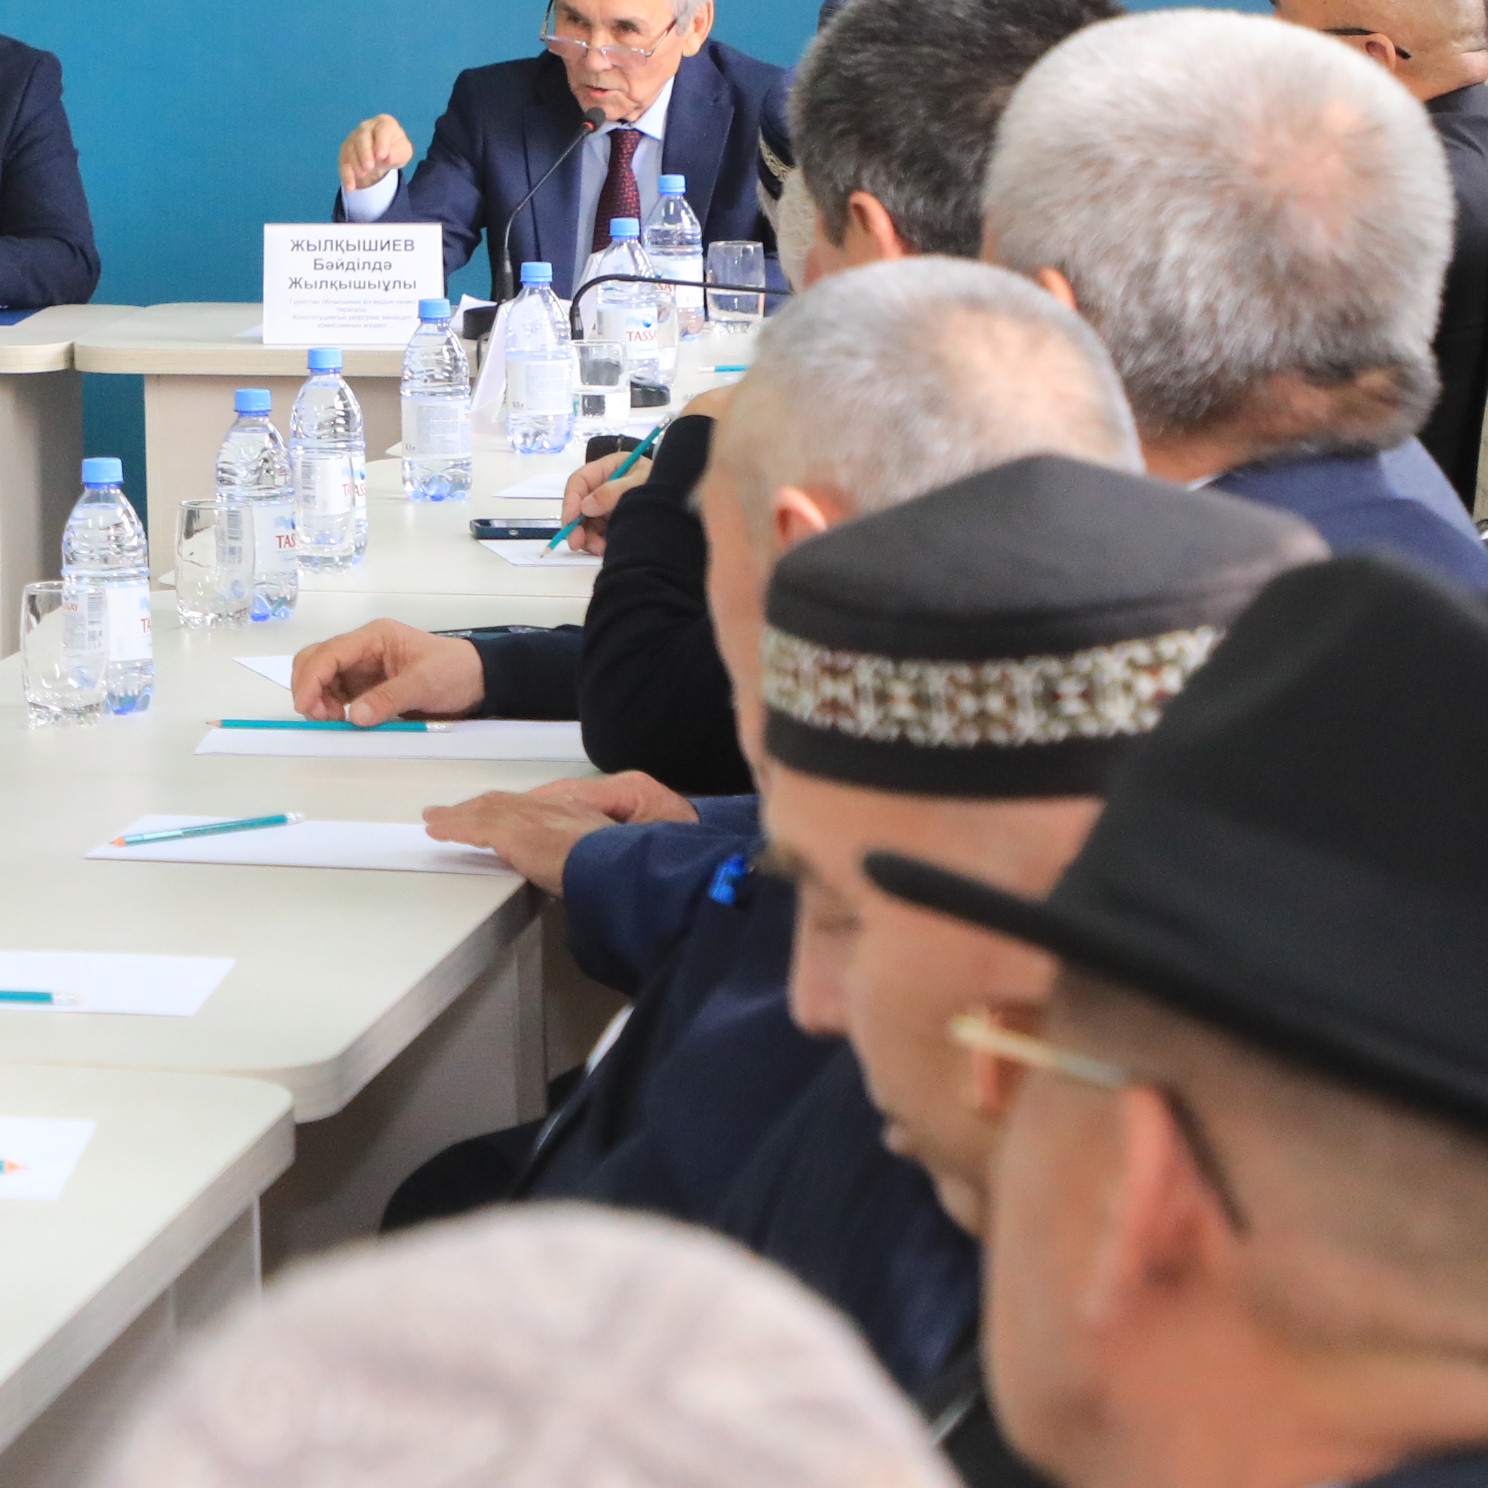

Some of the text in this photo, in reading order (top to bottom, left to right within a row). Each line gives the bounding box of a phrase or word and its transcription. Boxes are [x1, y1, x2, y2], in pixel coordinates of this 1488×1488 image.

[289, 239, 416, 254] ЖЫЛҚЫШИЕВ
[313, 258, 393, 273] Бәйділдә
[626, 329, 657, 343] TASS
